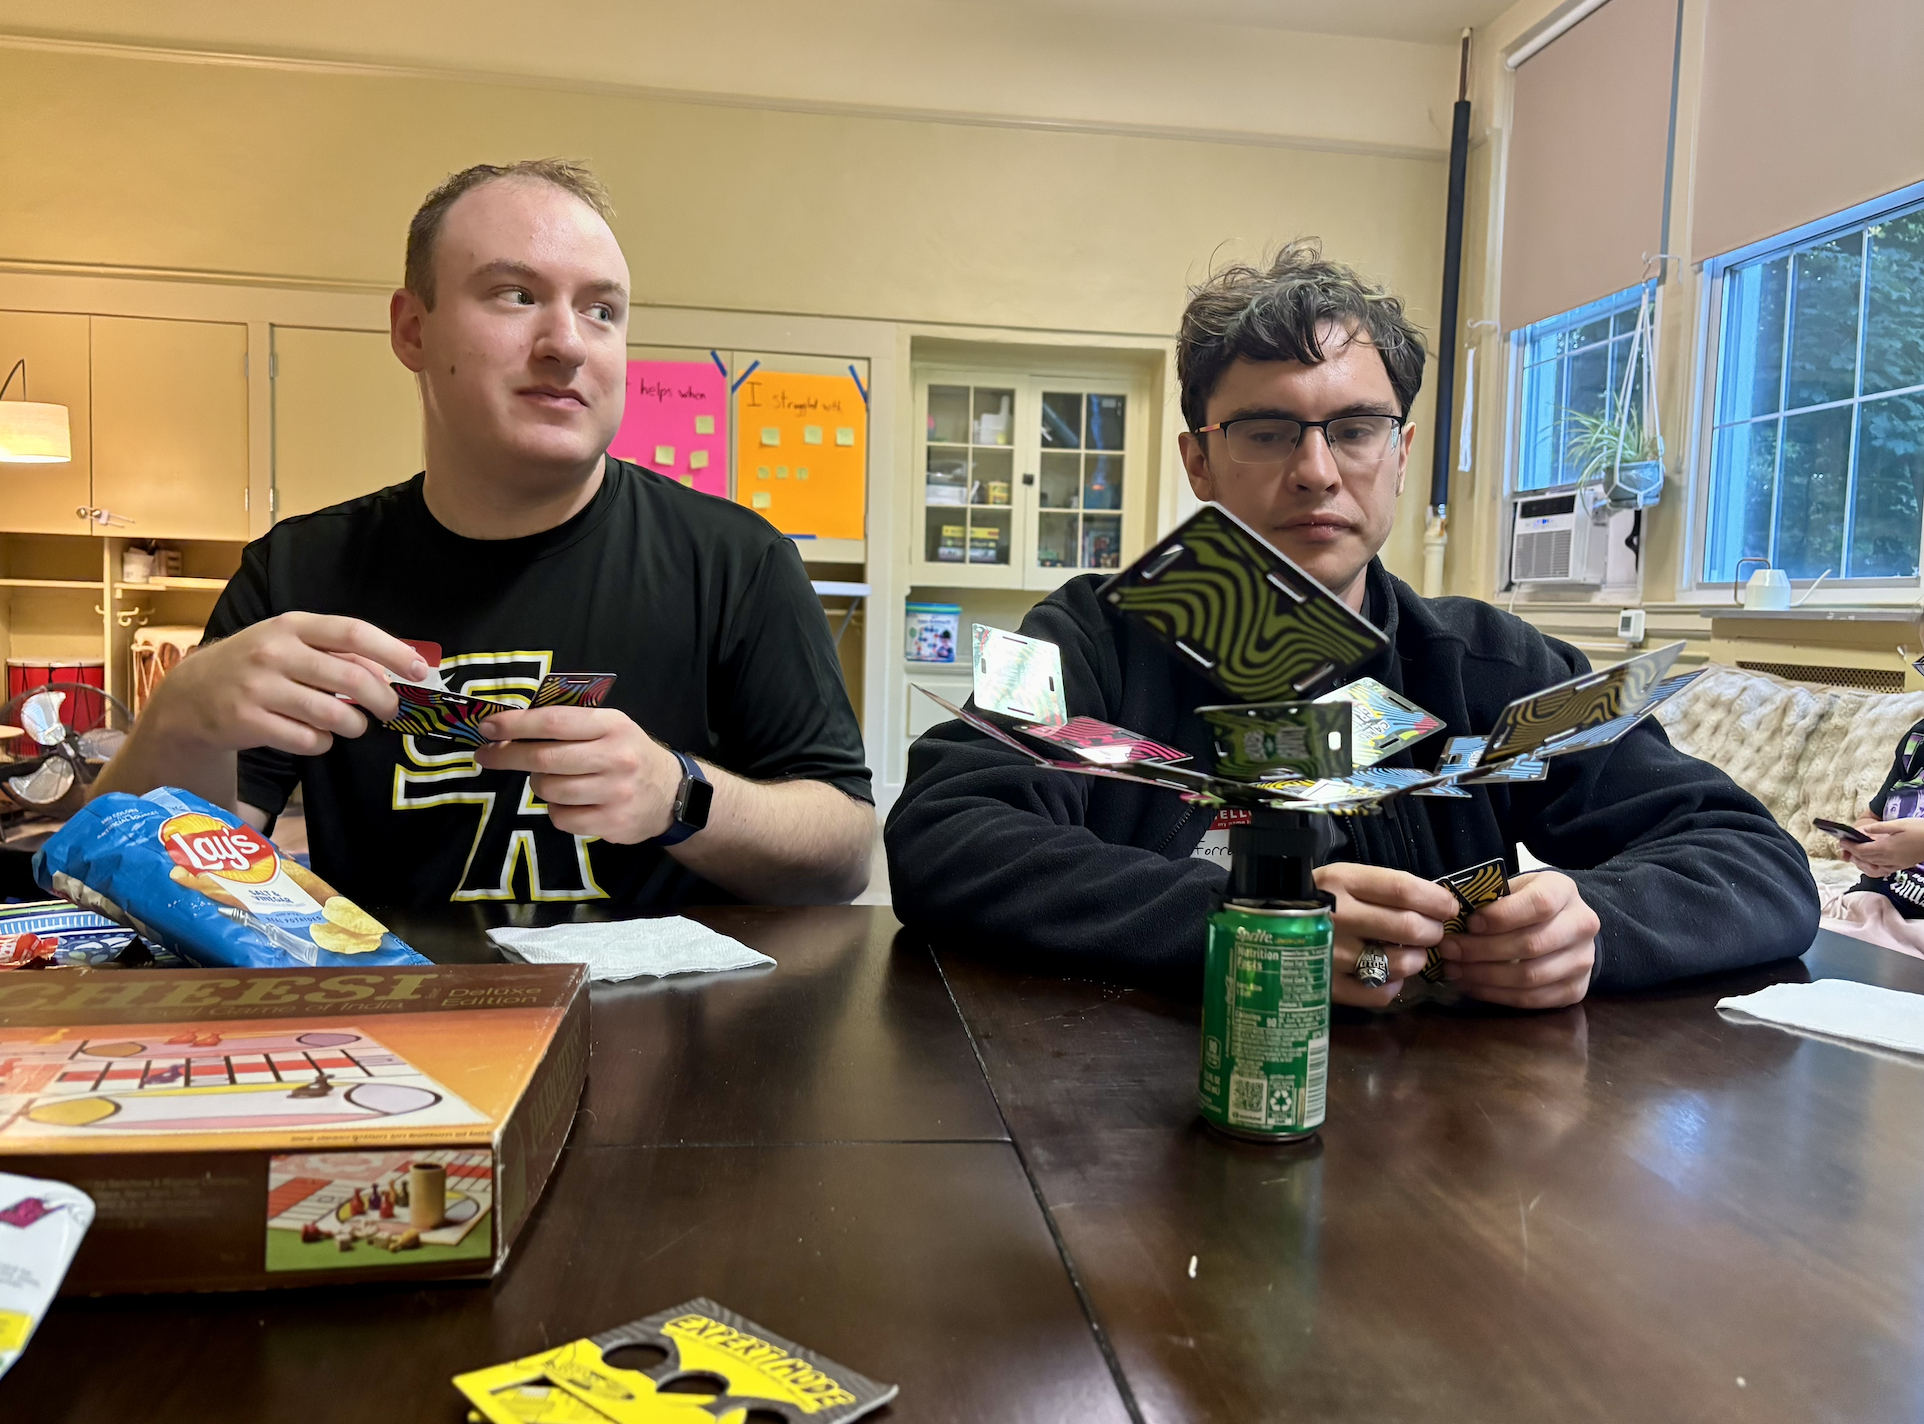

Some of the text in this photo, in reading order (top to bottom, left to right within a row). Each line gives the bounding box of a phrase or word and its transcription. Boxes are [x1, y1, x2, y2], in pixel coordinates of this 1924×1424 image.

[641, 378, 672, 402] helps
[679, 386, 706, 400] when
[747, 381, 762, 407] I
[1214, 809, 1252, 820] ELL
[170, 826, 260, 871] Lay's
[251, 896, 294, 904] VINEGAR
[1236, 926, 1273, 944] Sprite
[1237, 946, 1280, 960] Nutrition
[1237, 957, 1262, 971] Facts
[449, 987, 542, 997] Deluxe
[442, 995, 538, 1007] Edition
[209, 1005, 297, 1016] Game
[305, 1001, 337, 1013] of
[341, 1001, 404, 1011] India
[1266, 1017, 1277, 1028] 90
